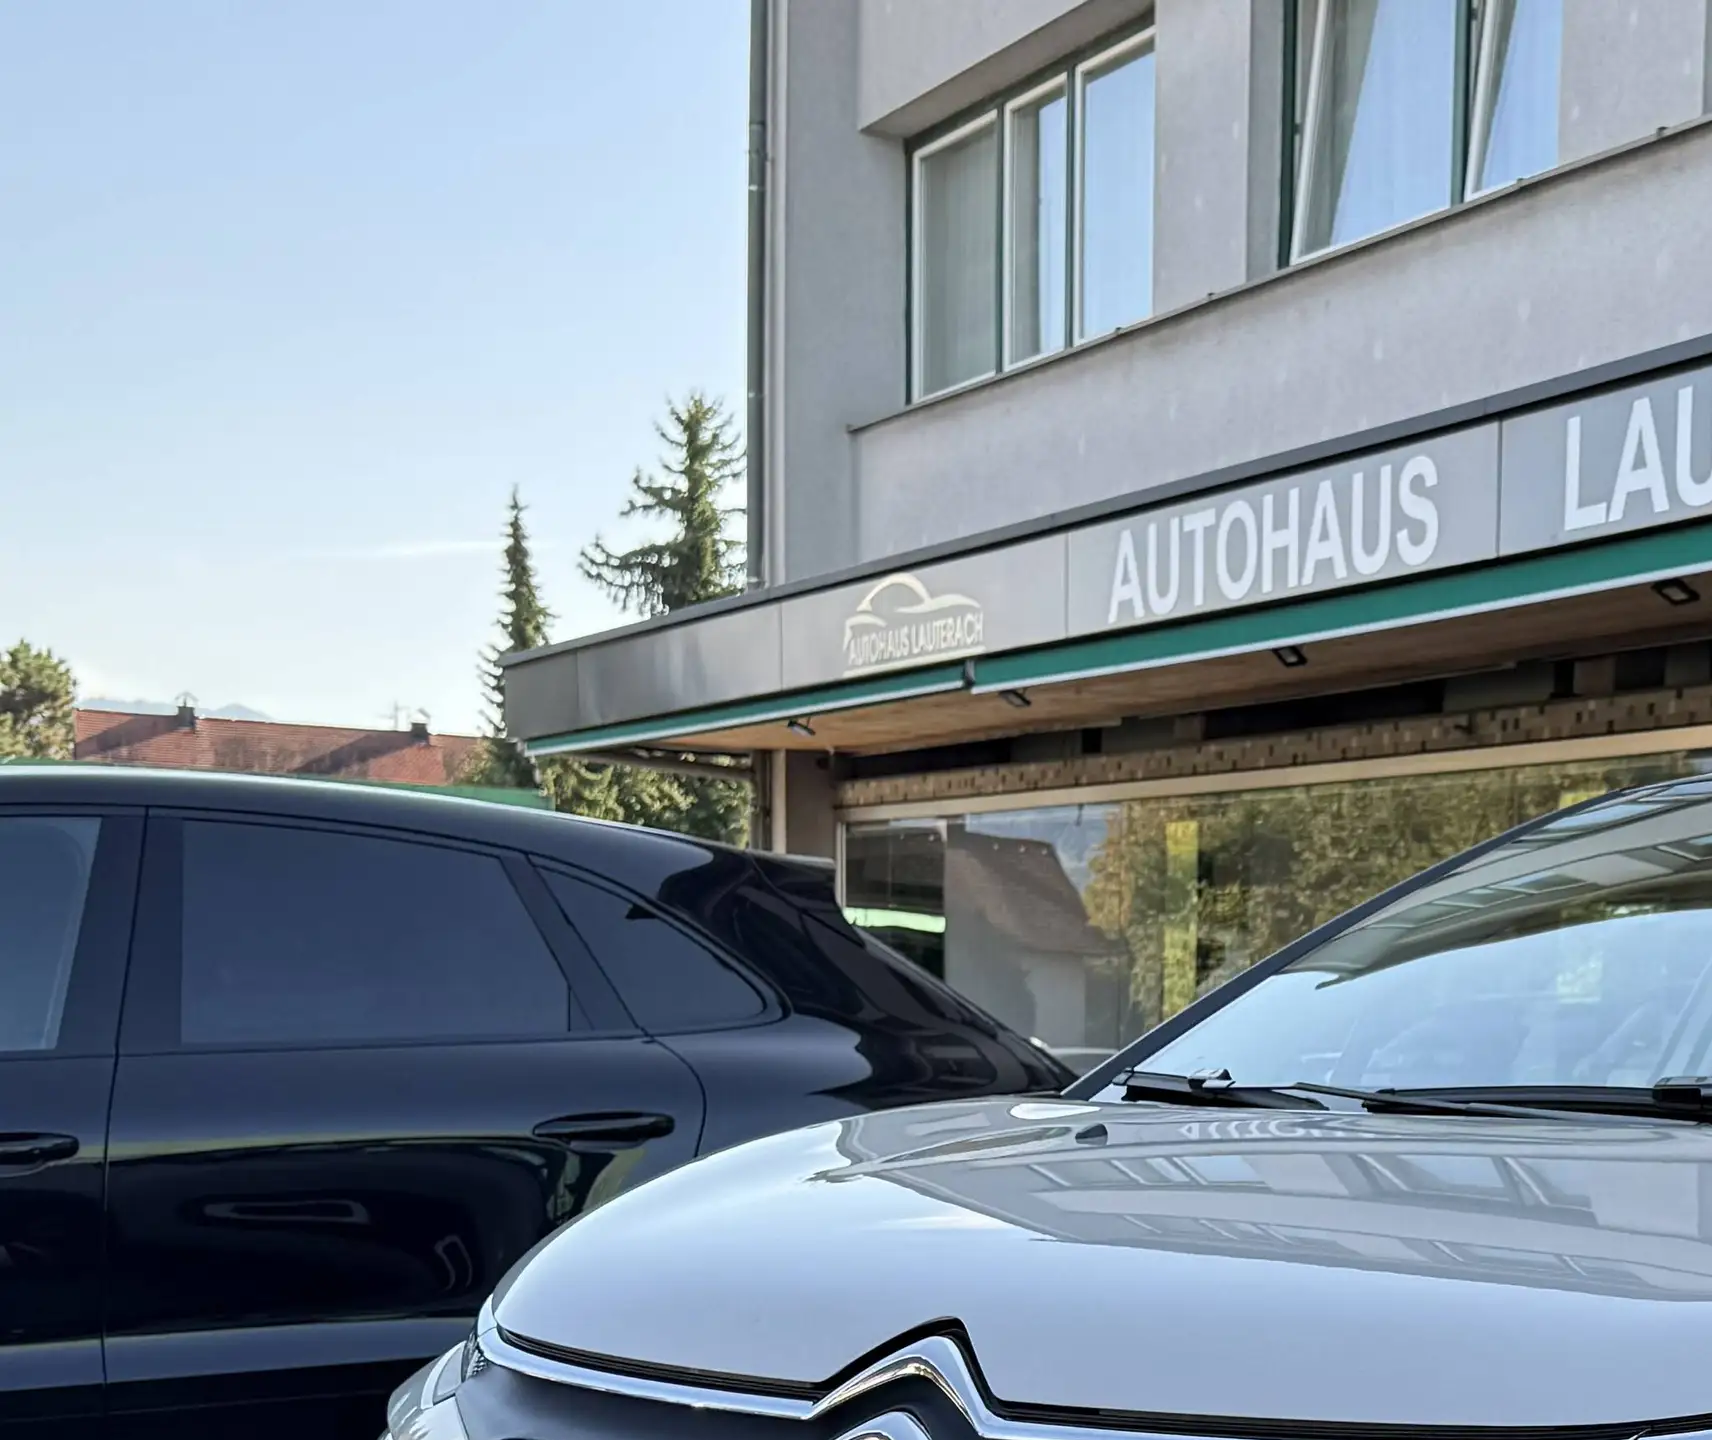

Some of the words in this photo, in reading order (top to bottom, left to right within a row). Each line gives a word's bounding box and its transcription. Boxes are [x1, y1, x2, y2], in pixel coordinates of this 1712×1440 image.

[1108, 455, 1441, 625] AUTOHAUS
[849, 624, 910, 667] AUTOHAUS
[911, 611, 984, 656] LAUTERACH
